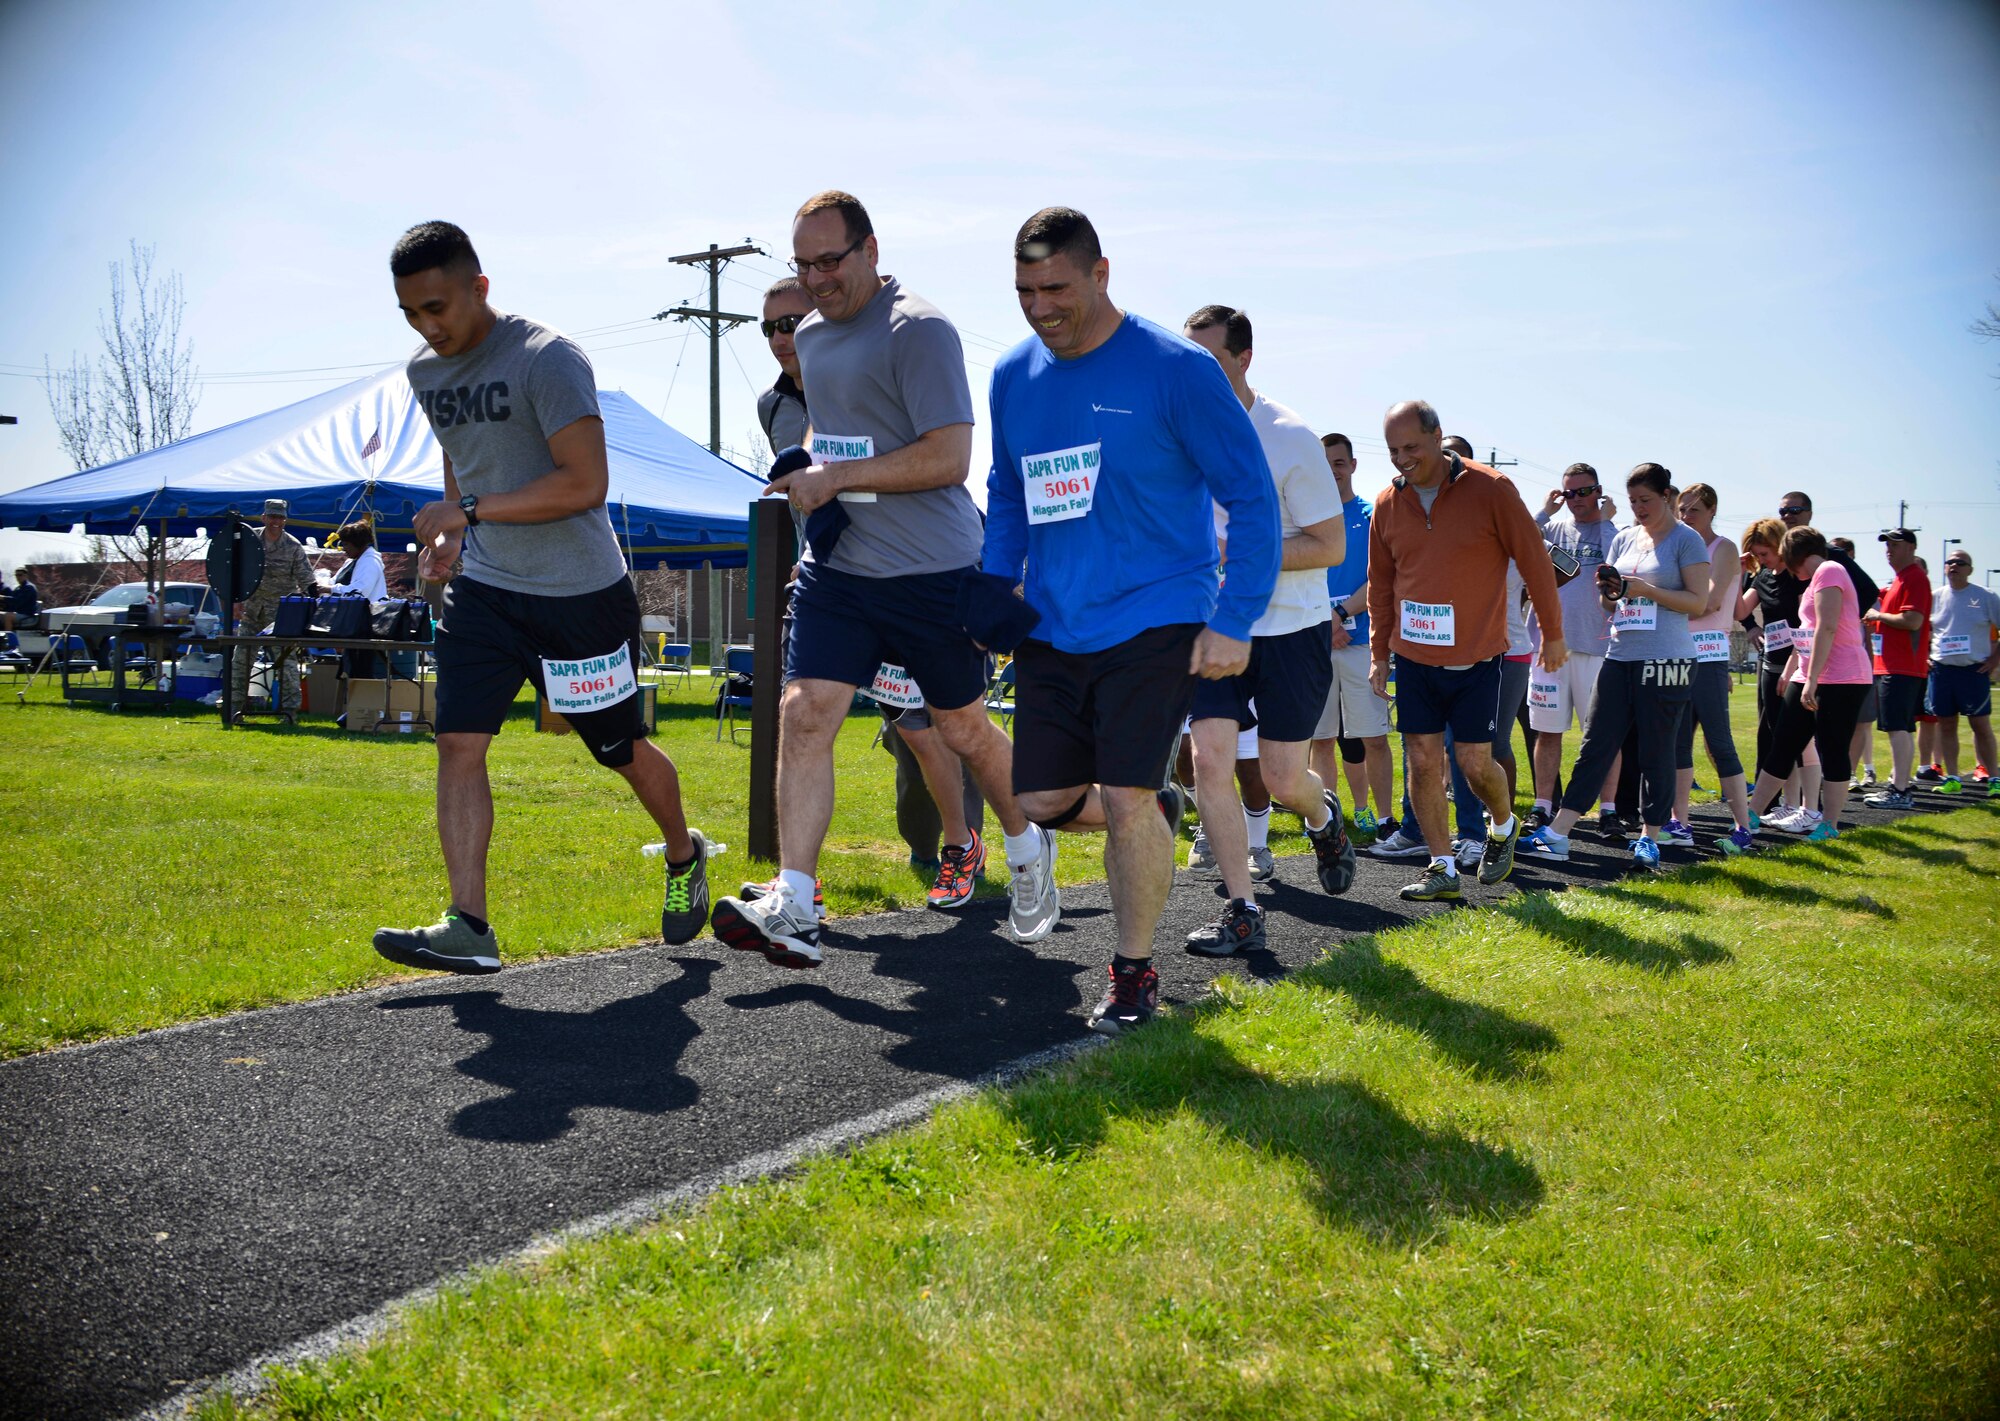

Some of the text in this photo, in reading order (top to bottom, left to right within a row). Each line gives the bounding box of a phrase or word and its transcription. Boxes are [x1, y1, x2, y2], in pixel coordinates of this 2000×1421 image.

[812, 438, 868, 458] SAPR FUN RUN
[1027, 460, 1053, 478] SAPR
[1054, 454, 1080, 474] FUN
[1045, 476, 1090, 498] 5061
[1032, 502, 1068, 516] Niagara
[1417, 605, 1432, 617] FUN
[1433, 606, 1451, 617] RUN
[1410, 618, 1436, 631] 5061
[1402, 628, 1421, 638] Niagara
[1421, 632, 1436, 640] Falls
[1705, 633, 1717, 641] FUN
[1698, 643, 1720, 652] 5061
[550, 648, 627, 677] SAPR FUN RUN
[1640, 664, 1692, 687] PINK
[570, 675, 614, 694] 5061
[874, 677, 910, 694] 5061
[554, 680, 633, 708] Niagara Falls ARS
[887, 693, 906, 704] Falls
[907, 696, 922, 704] ARS
